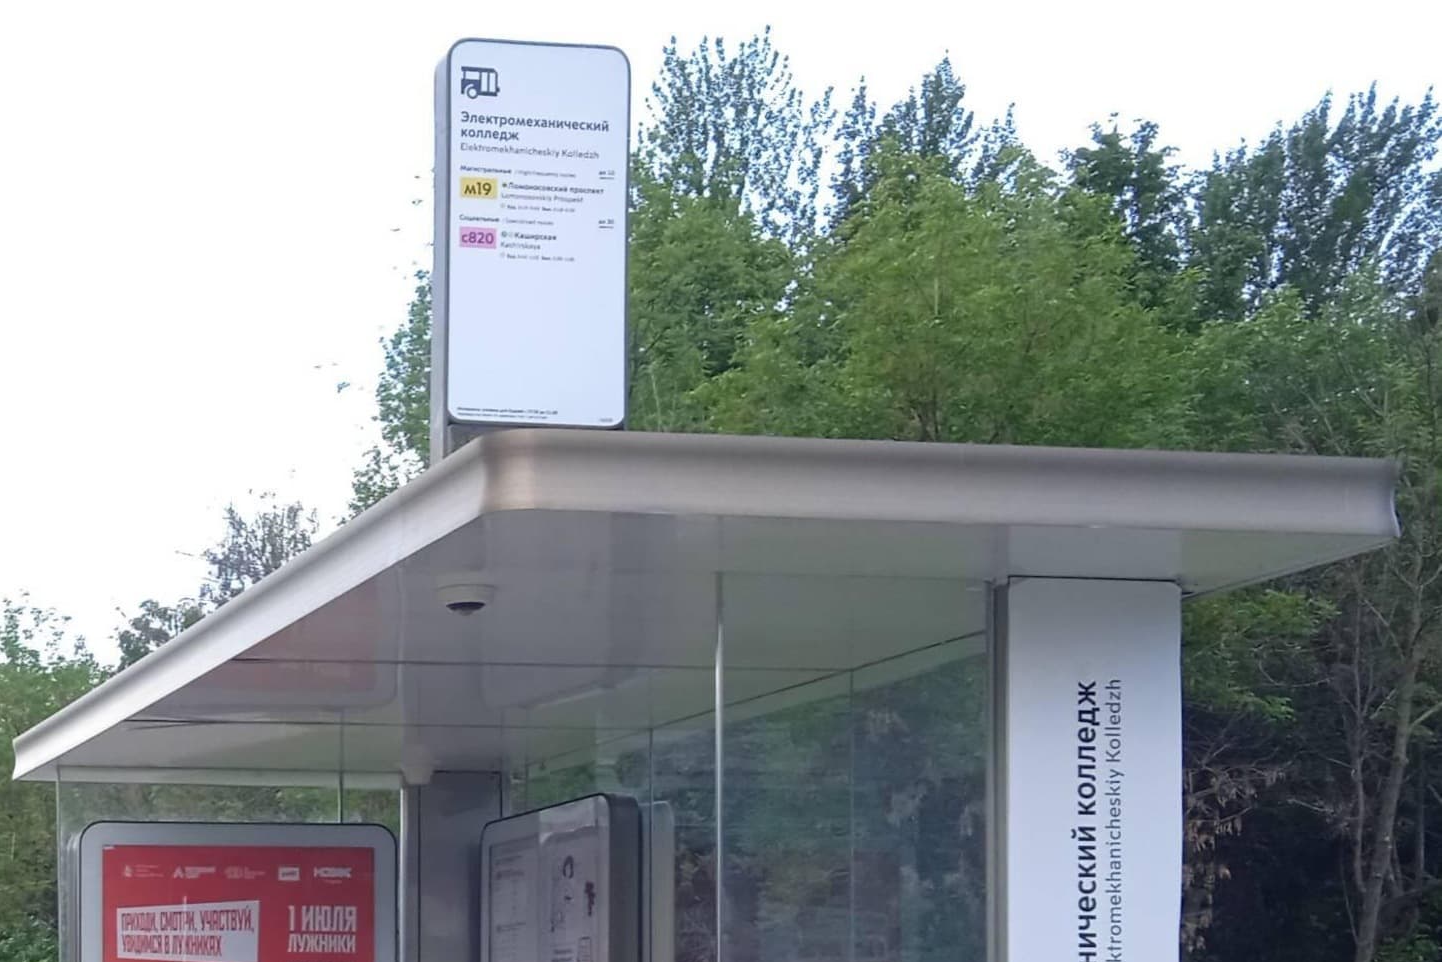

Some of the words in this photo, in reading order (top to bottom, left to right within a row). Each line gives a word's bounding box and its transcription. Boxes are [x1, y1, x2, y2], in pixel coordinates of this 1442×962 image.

[460, 110, 609, 132] Электромеханический
[460, 127, 519, 141] колледж
[463, 182, 492, 196] м19
[461, 232, 494, 245] с820
[1105, 678, 1122, 766] Kolledzh
[1076, 680, 1100, 816] колледж
[199, 904, 255, 934] УЧАСТВУЙ,
[301, 905, 357, 932] ИЮЛЯ
[287, 933, 356, 954] ЛУЖНИКИ
